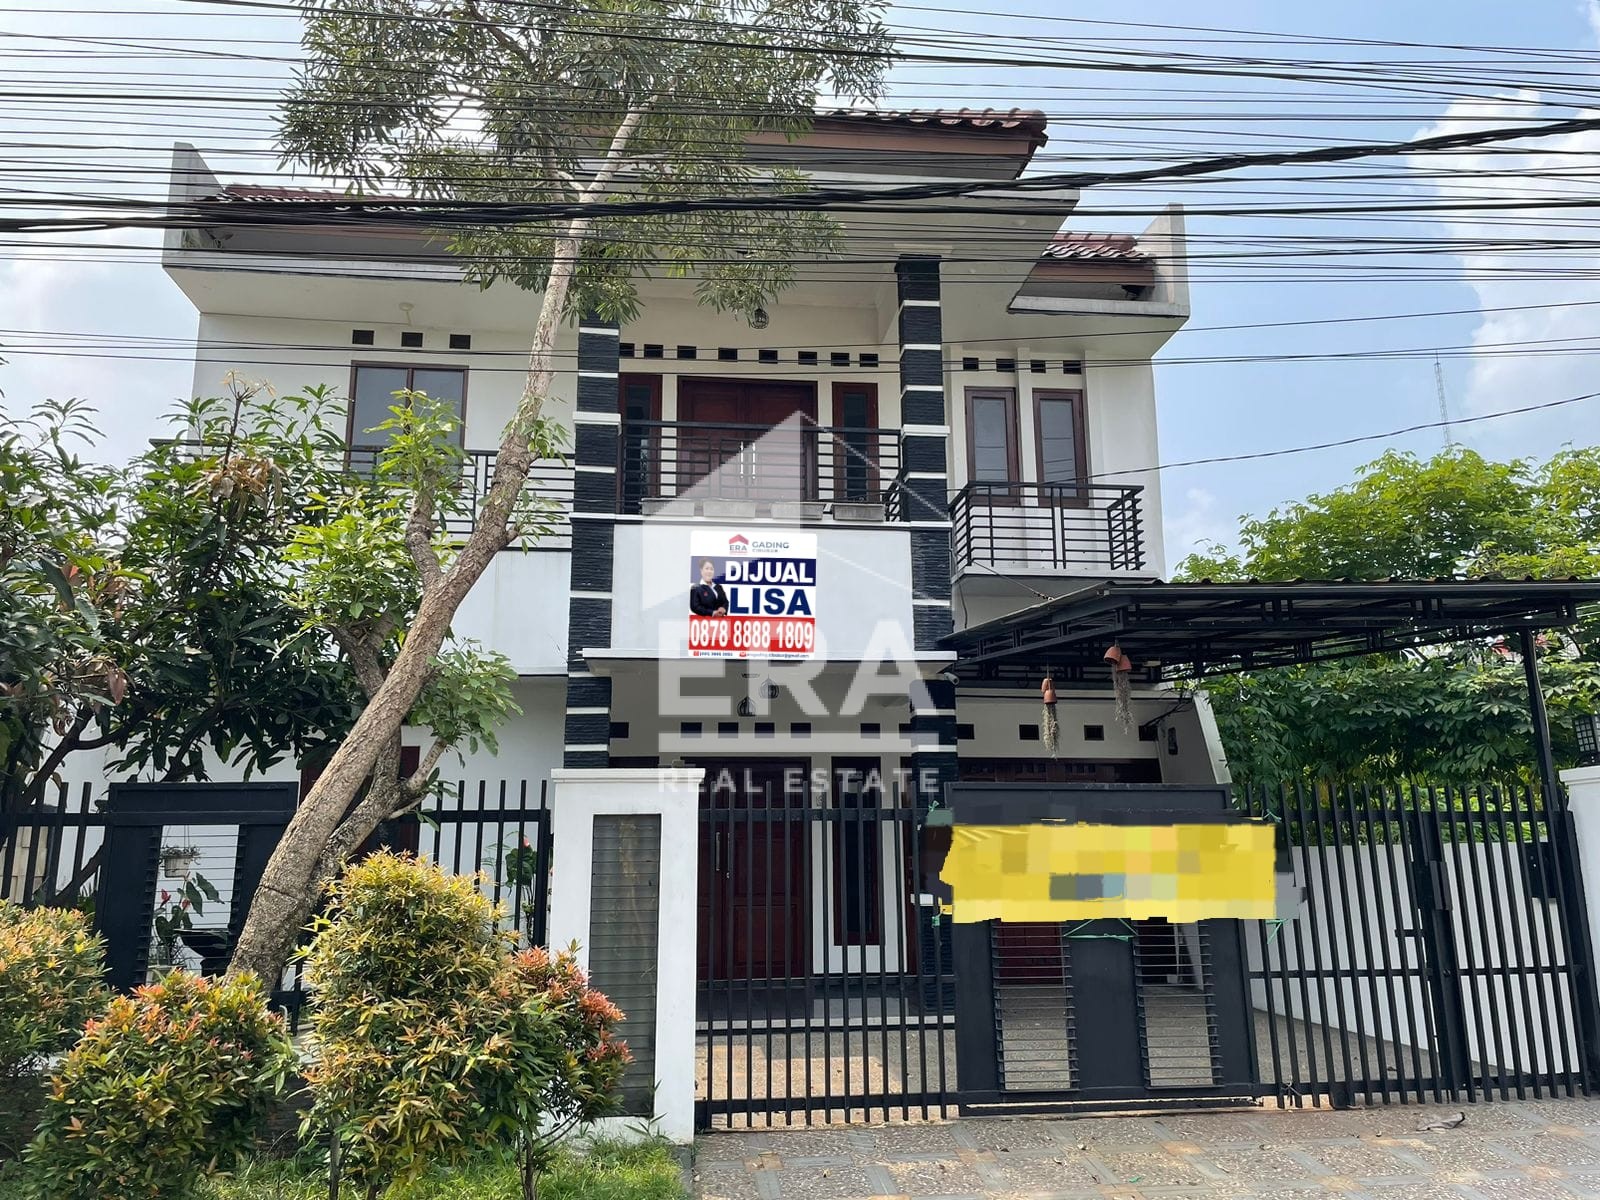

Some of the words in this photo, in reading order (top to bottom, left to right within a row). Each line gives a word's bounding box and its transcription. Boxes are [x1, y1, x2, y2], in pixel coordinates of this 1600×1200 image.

[752, 541, 789, 549] GADING
[725, 561, 813, 583] DIJUAL
[730, 588, 812, 615] LISA
[691, 620, 728, 647] 0878
[733, 621, 770, 648] 8888
[776, 622, 813, 649] 1809
